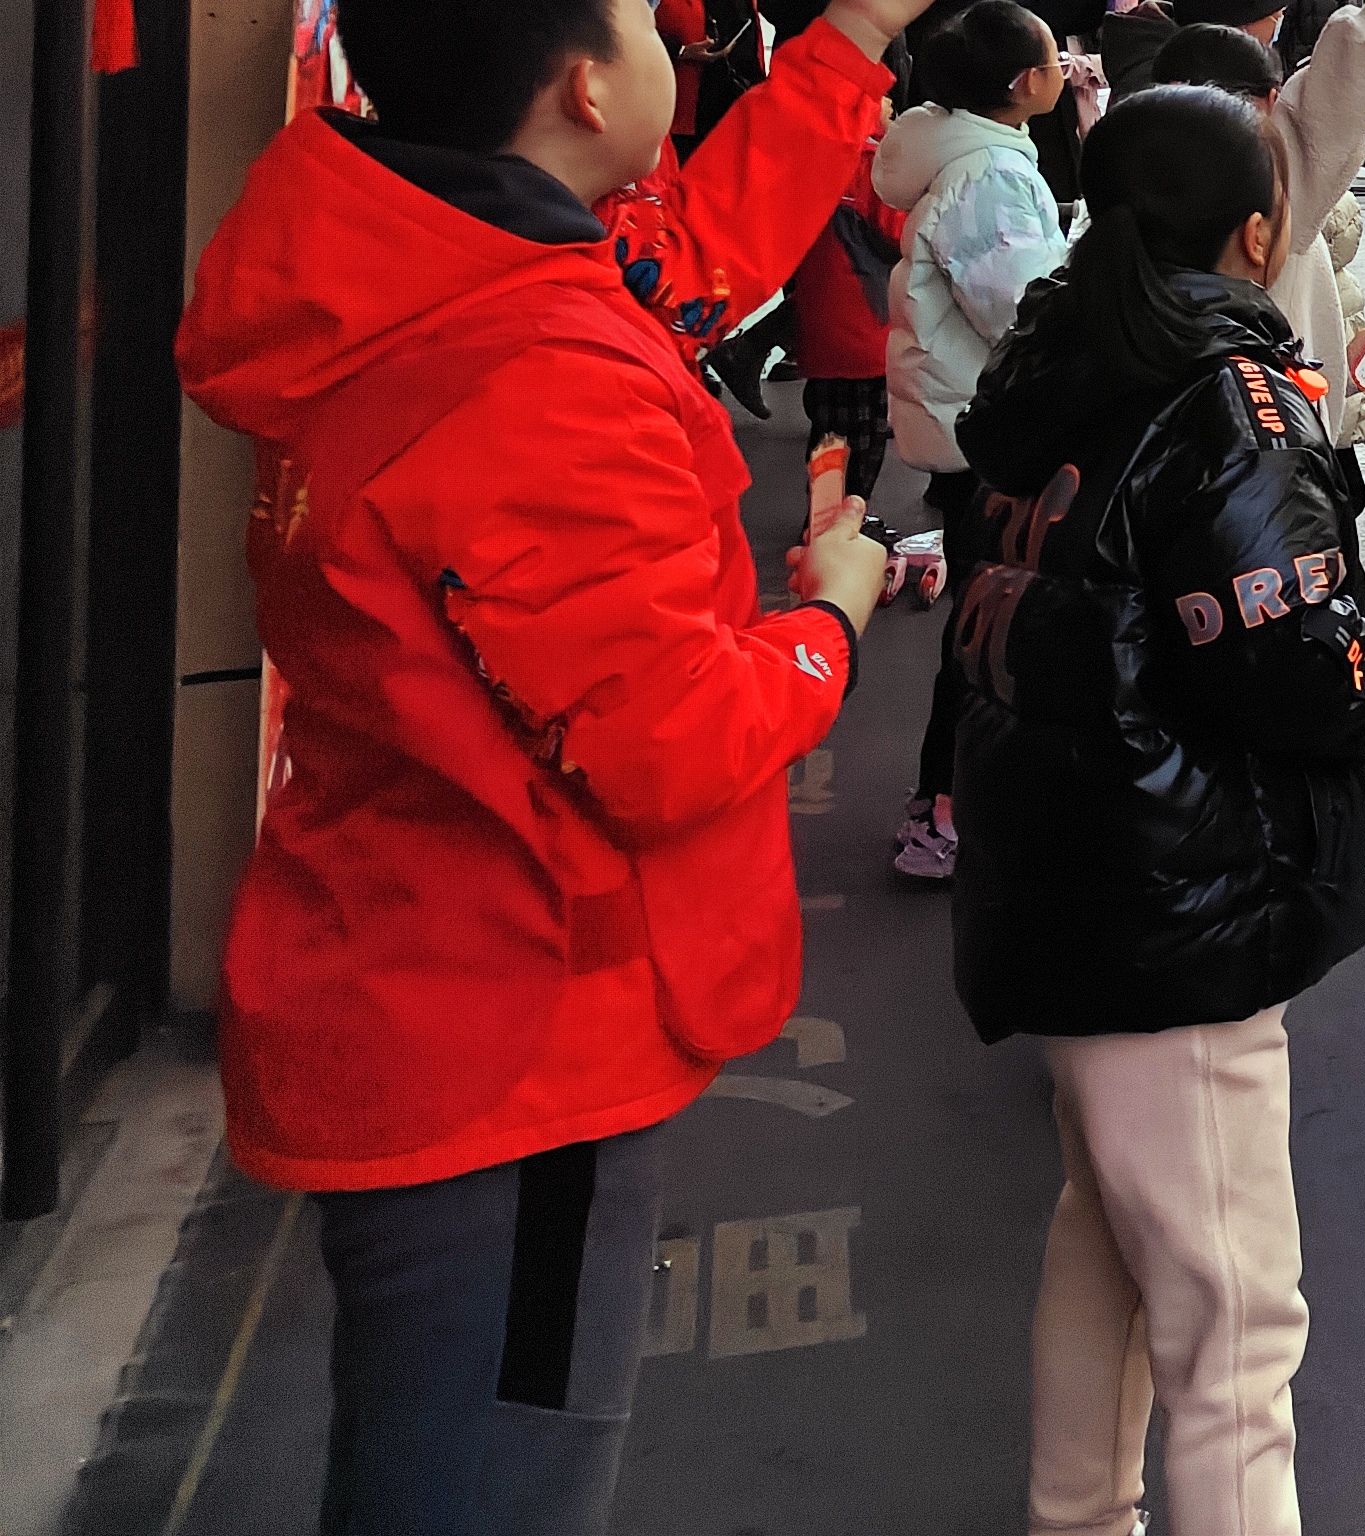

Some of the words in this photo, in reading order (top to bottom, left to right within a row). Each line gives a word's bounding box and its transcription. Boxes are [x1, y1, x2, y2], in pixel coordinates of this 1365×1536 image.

[1237, 362, 1275, 404] GIVE
[1256, 408, 1286, 433] UP
[1175, 552, 1347, 646] DRE
